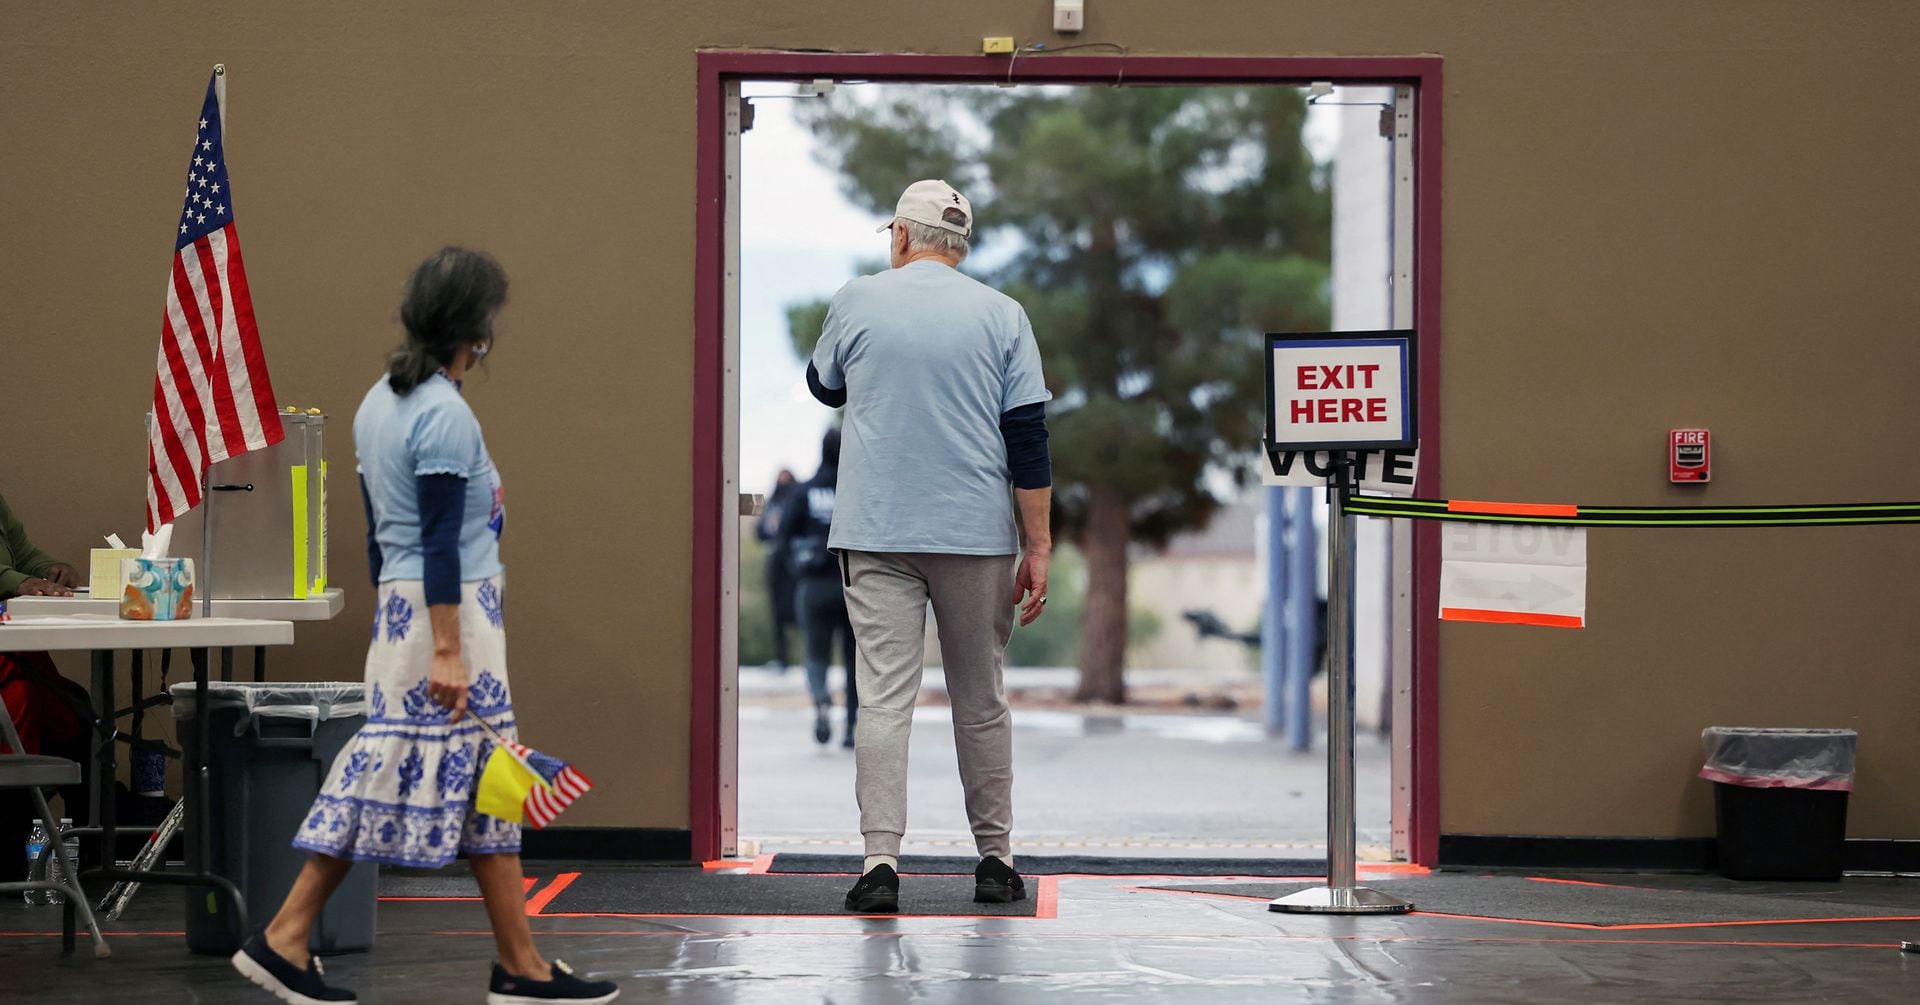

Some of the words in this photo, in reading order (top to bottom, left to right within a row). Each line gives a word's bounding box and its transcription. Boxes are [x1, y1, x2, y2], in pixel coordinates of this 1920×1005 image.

[1297, 364, 1380, 390] EXIT
[1291, 397, 1388, 424] HERE
[1675, 432, 1705, 443] FIRE
